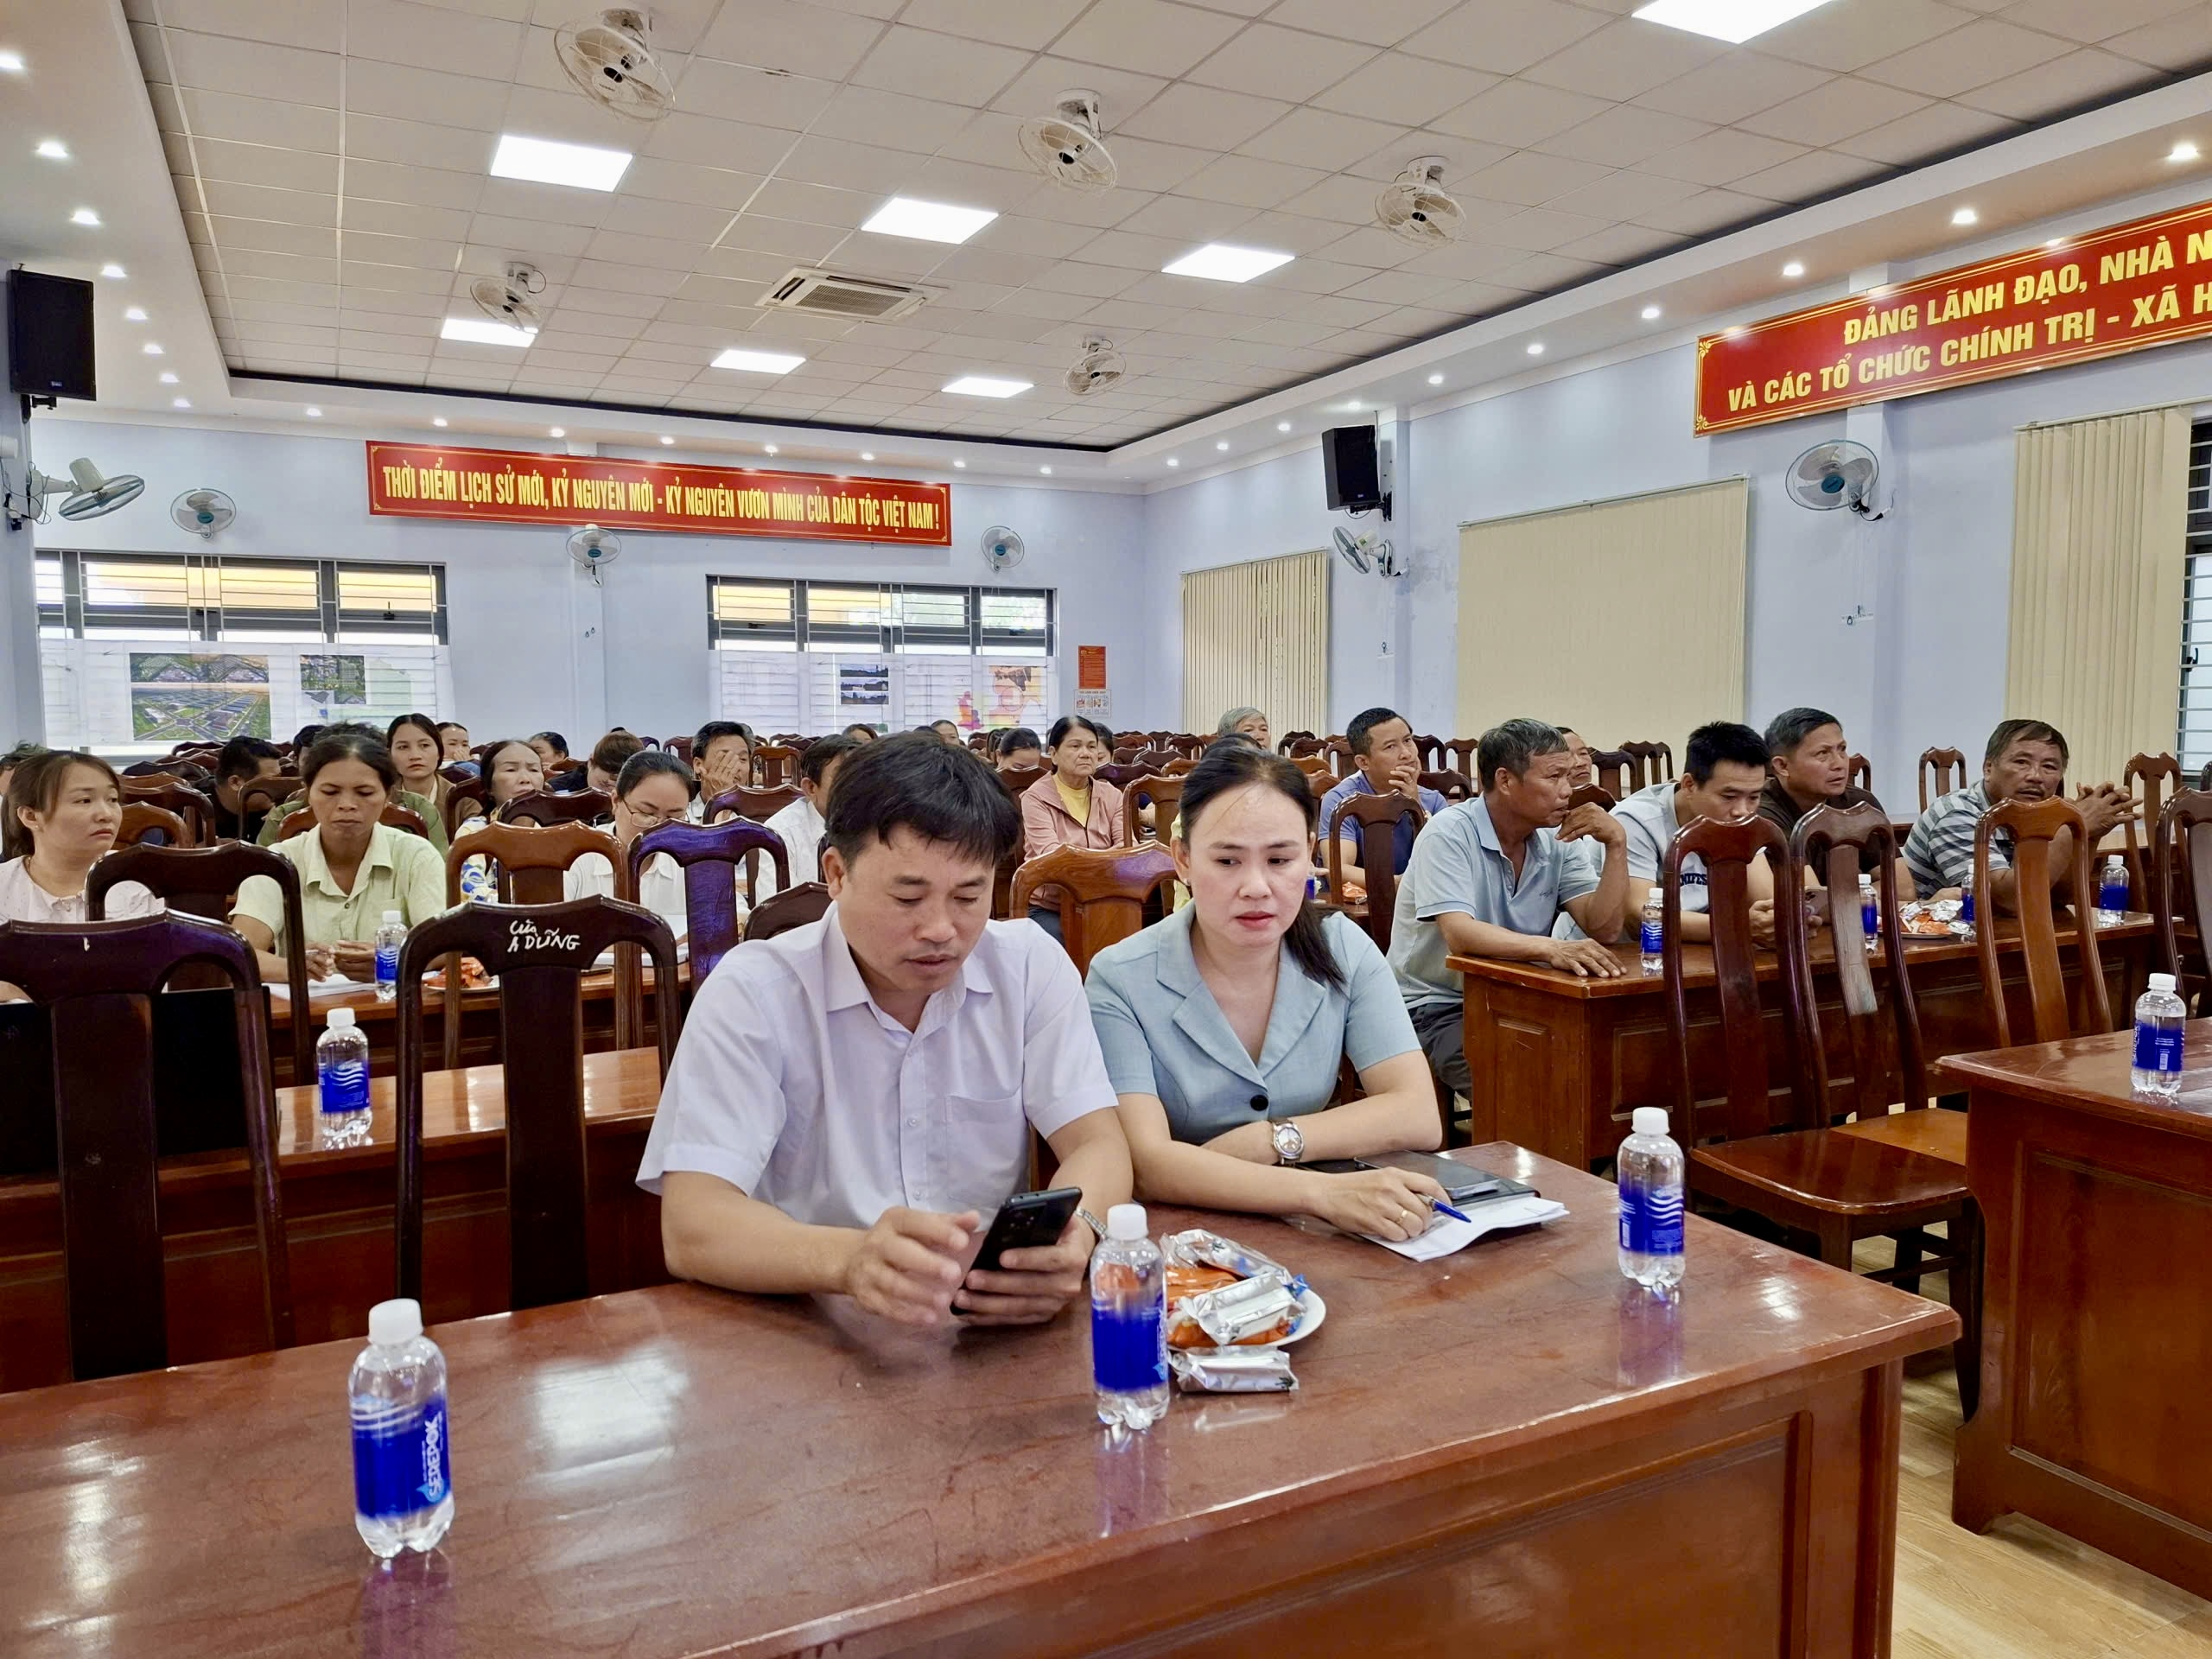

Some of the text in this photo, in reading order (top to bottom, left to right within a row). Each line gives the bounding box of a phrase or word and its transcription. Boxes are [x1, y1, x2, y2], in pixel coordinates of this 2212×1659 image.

[1843, 304, 1918, 345] ĐẢNG
[1926, 282, 2005, 327] LÃNH
[2013, 264, 2088, 305] ĐẠO,
[2099, 235, 2175, 285] NHÀ
[1728, 380, 1757, 412] VÀ
[1764, 371, 1812, 404] CÁC
[1819, 353, 1852, 391] TỔ
[1858, 344, 1931, 384] CHỨC
[1940, 321, 2034, 367] CHÍNH
[2044, 308, 2095, 345] TRỊ
[2130, 283, 2181, 328] XÃ
[383, 460, 416, 499] THỜI
[419, 456, 457, 502] ĐIỂM
[460, 471, 493, 509] LỊCH
[495, 463, 515, 505] SỬ
[518, 469, 550, 511] MỚI,
[551, 467, 569, 508] KỶ
[572, 474, 626, 511] NGUYÊN
[628, 476, 655, 513] MỚI
[664, 476, 682, 515] KỶ
[684, 482, 735, 518] NGUYÊN
[736, 487, 770, 520] VƯƠN
[772, 486, 804, 522] MÌNH
[806, 486, 831, 524] CỦA
[832, 492, 857, 525] DÂN
[858, 493, 880, 532] TỘC
[881, 494, 906, 533] VIỆT
[907, 501, 934, 530] NAM
[506, 926, 582, 953] A DŨNG
